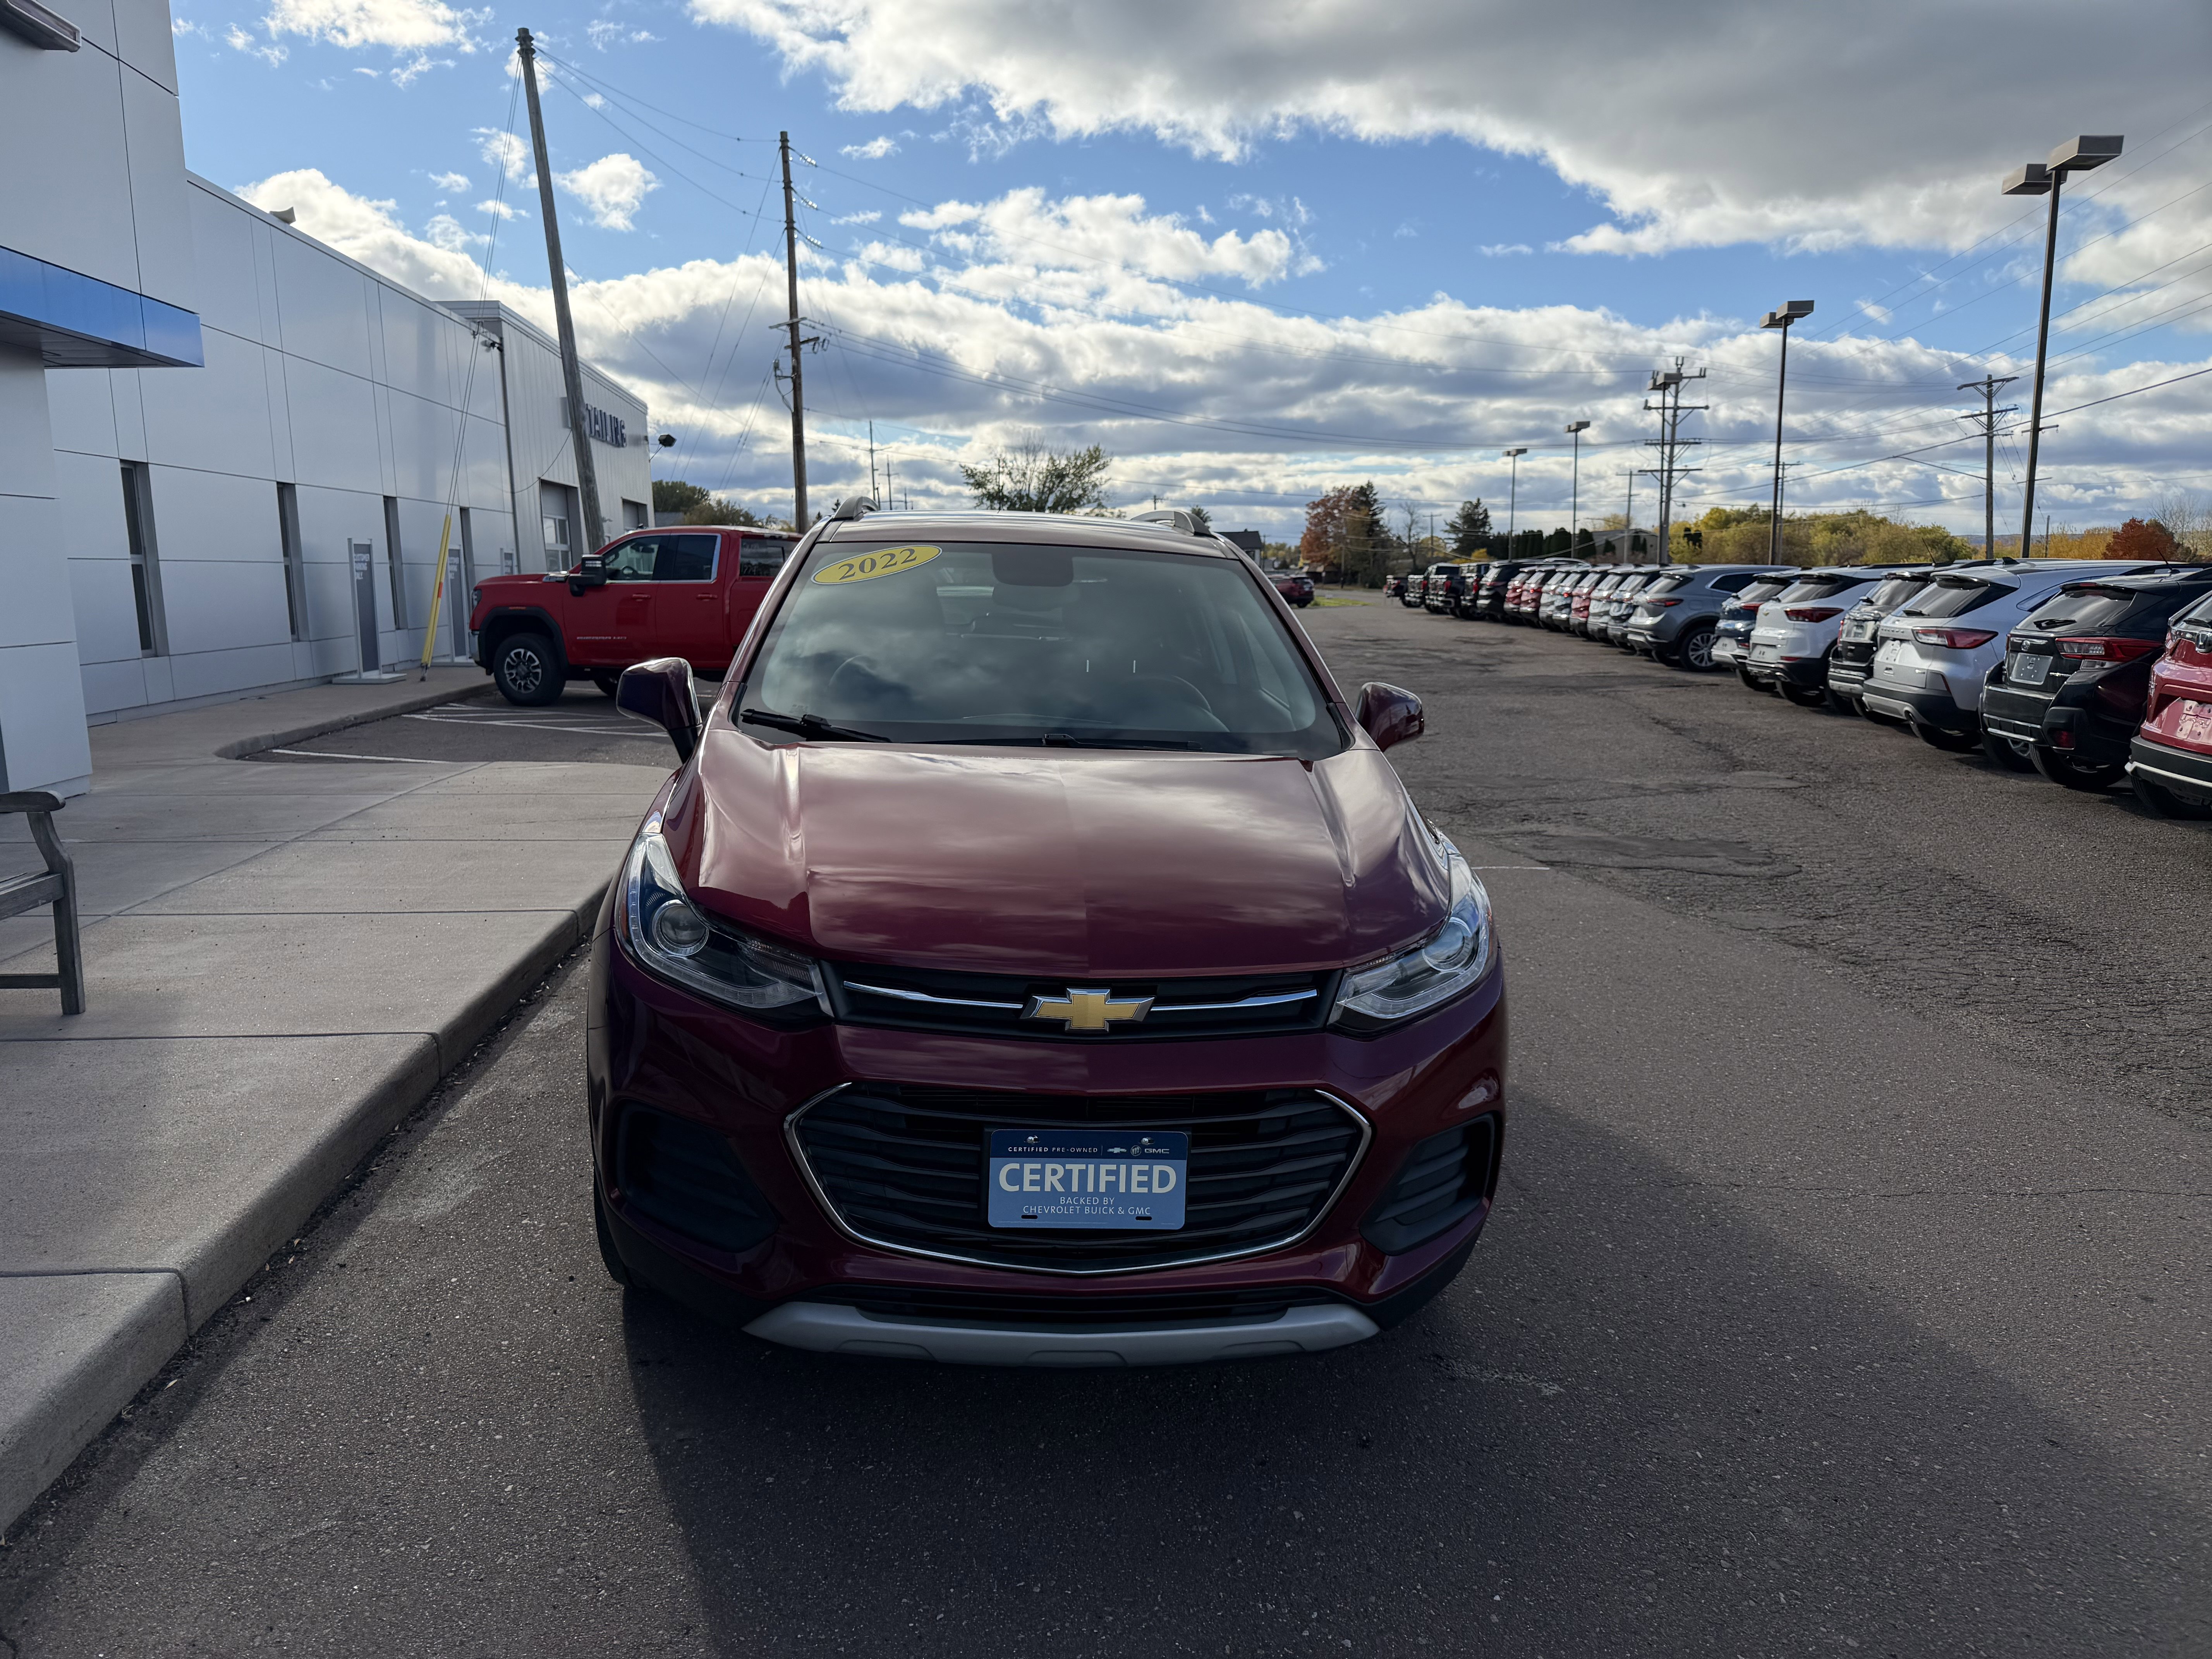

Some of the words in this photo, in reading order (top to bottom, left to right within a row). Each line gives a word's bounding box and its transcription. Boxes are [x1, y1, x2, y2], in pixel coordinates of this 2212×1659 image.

[838, 548, 917, 580] 2022
[999, 1163, 1176, 1193] CERTIFIED
[1023, 1206, 1080, 1214] CHEVROLET
[1085, 1206, 1115, 1214] BUICK
[1060, 1197, 1099, 1205] BACKED
